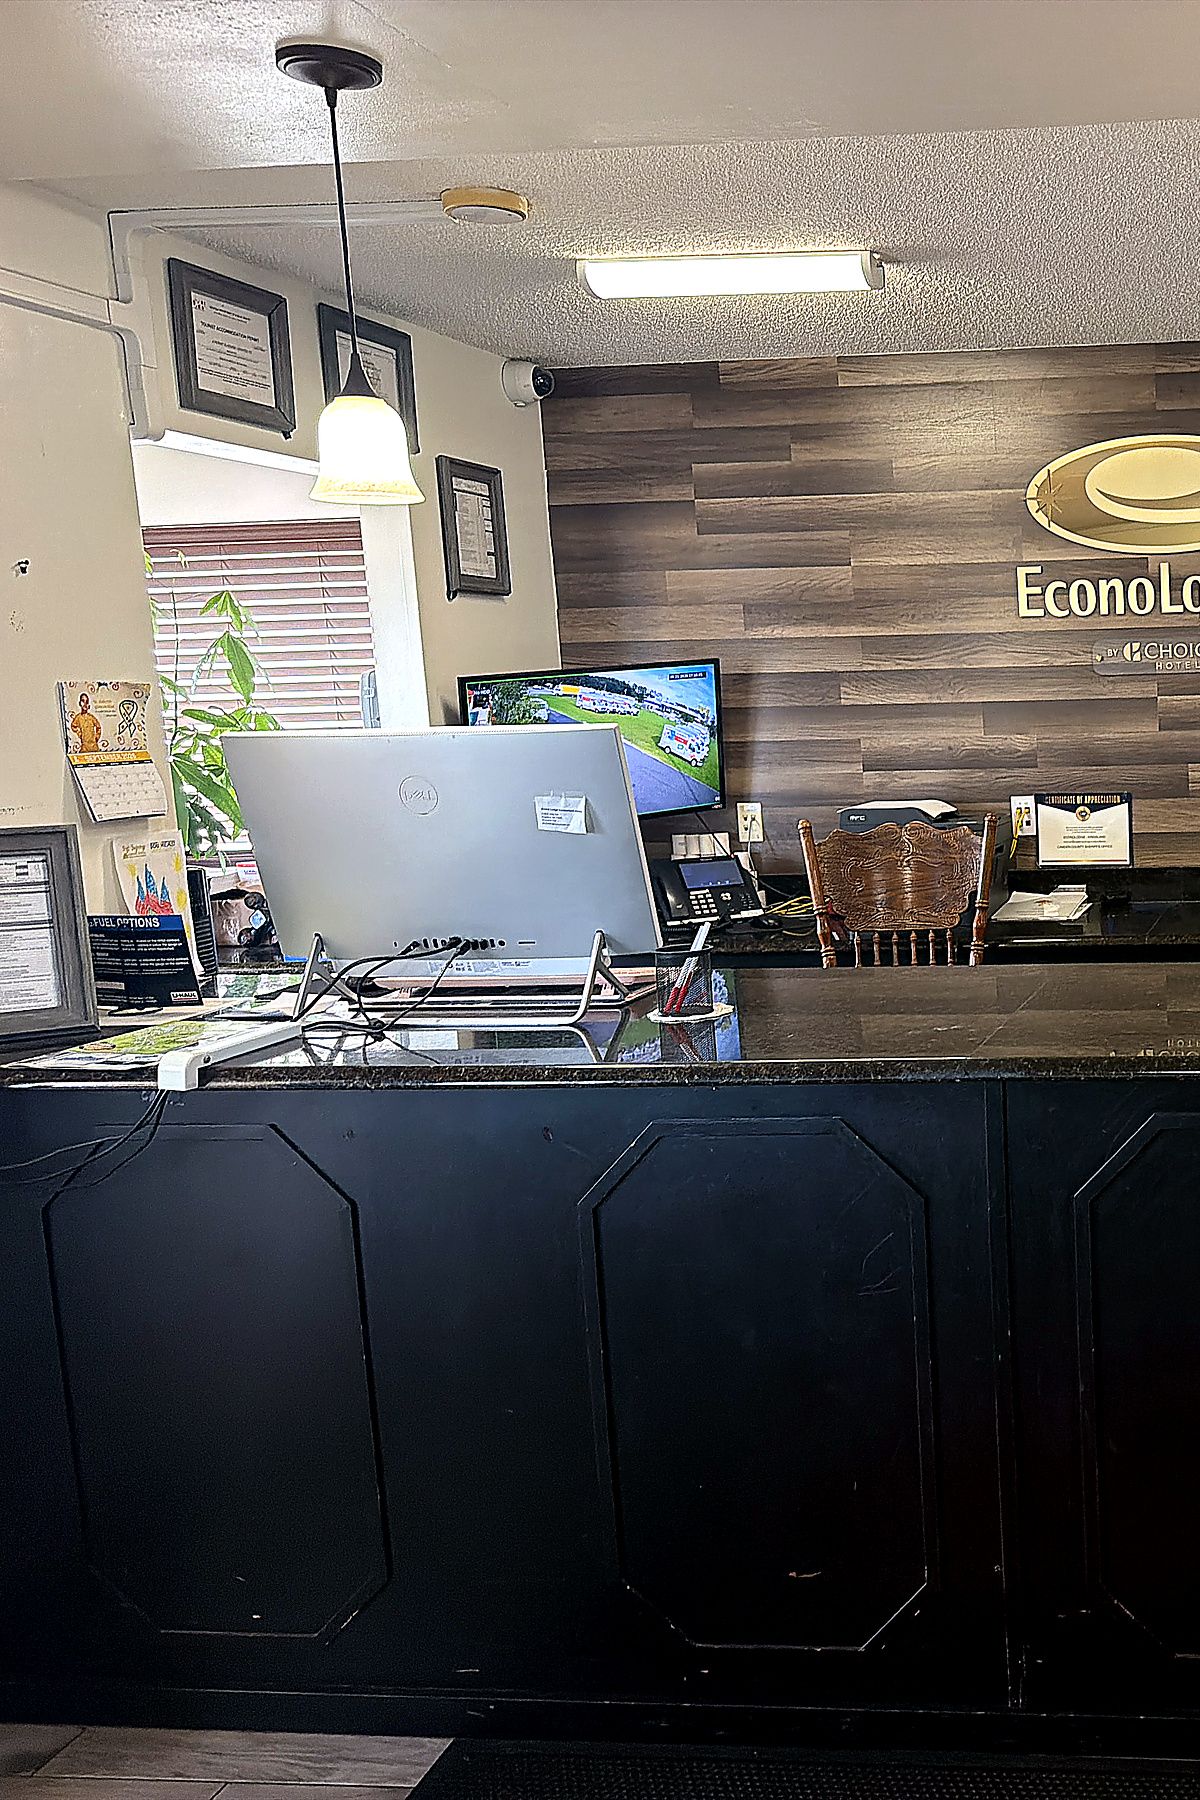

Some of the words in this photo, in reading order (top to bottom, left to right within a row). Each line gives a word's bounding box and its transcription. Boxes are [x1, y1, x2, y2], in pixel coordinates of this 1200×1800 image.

[1107, 648, 1118, 657] BY
[1084, 795, 1120, 804] APPRECIATION
[94, 918, 115, 928] FUEL
[116, 918, 160, 928] OPTIONS
